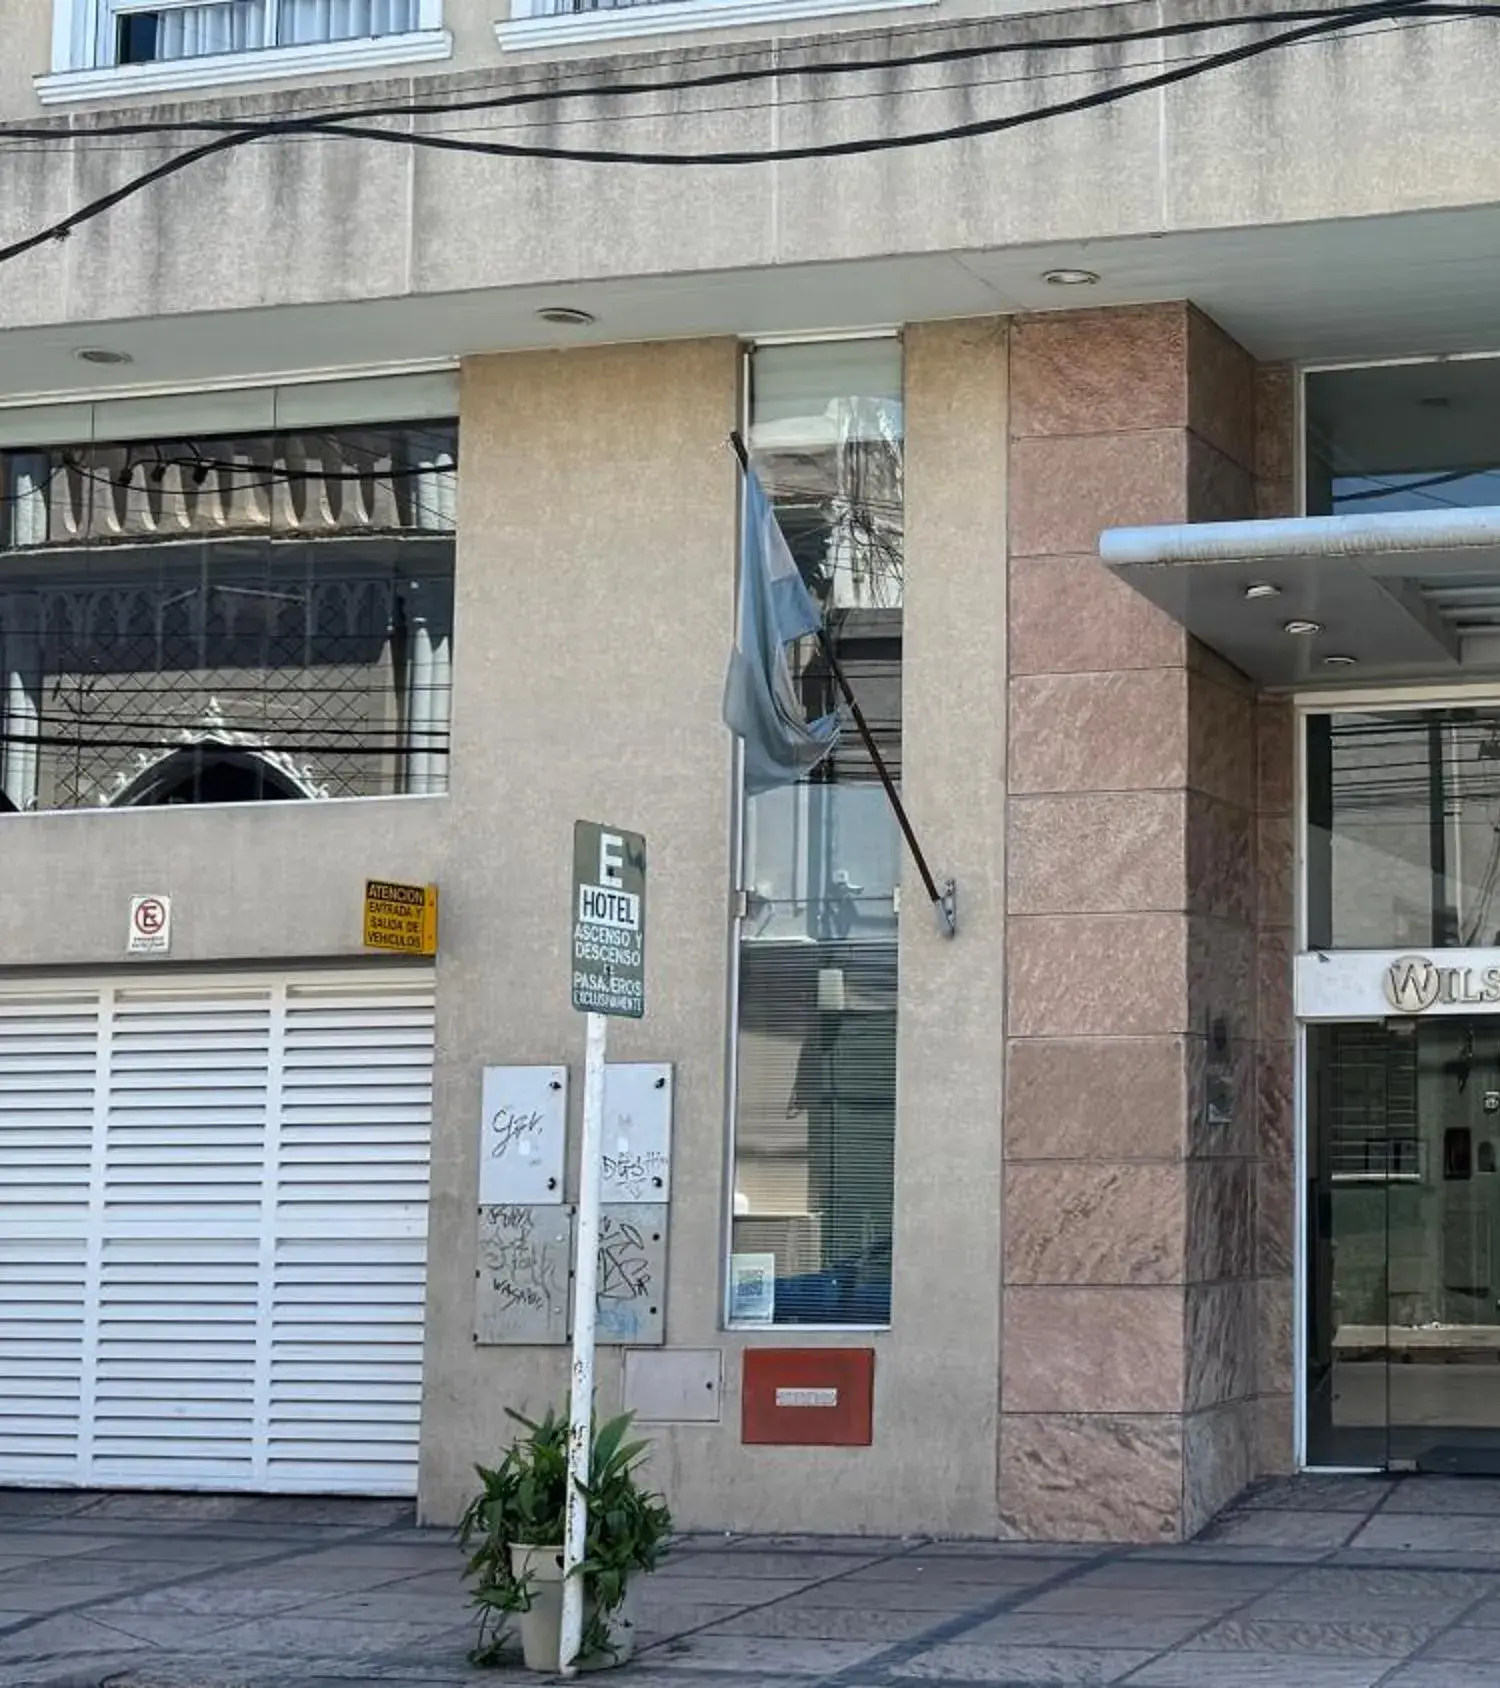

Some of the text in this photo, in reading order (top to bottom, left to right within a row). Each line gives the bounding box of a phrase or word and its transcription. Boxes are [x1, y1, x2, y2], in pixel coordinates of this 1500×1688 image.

[600, 832, 623, 889] E
[368, 884, 423, 905] ATENCION
[583, 889, 635, 924] HOTEL
[369, 902, 423, 918] ENTRADA Y
[370, 916, 420, 934] SALIDA DE
[575, 923, 643, 949] ASCENSO Y
[368, 931, 421, 949] VEHICULOS
[575, 942, 641, 967] DESCENSO
[573, 971, 642, 997] PASAJEROS
